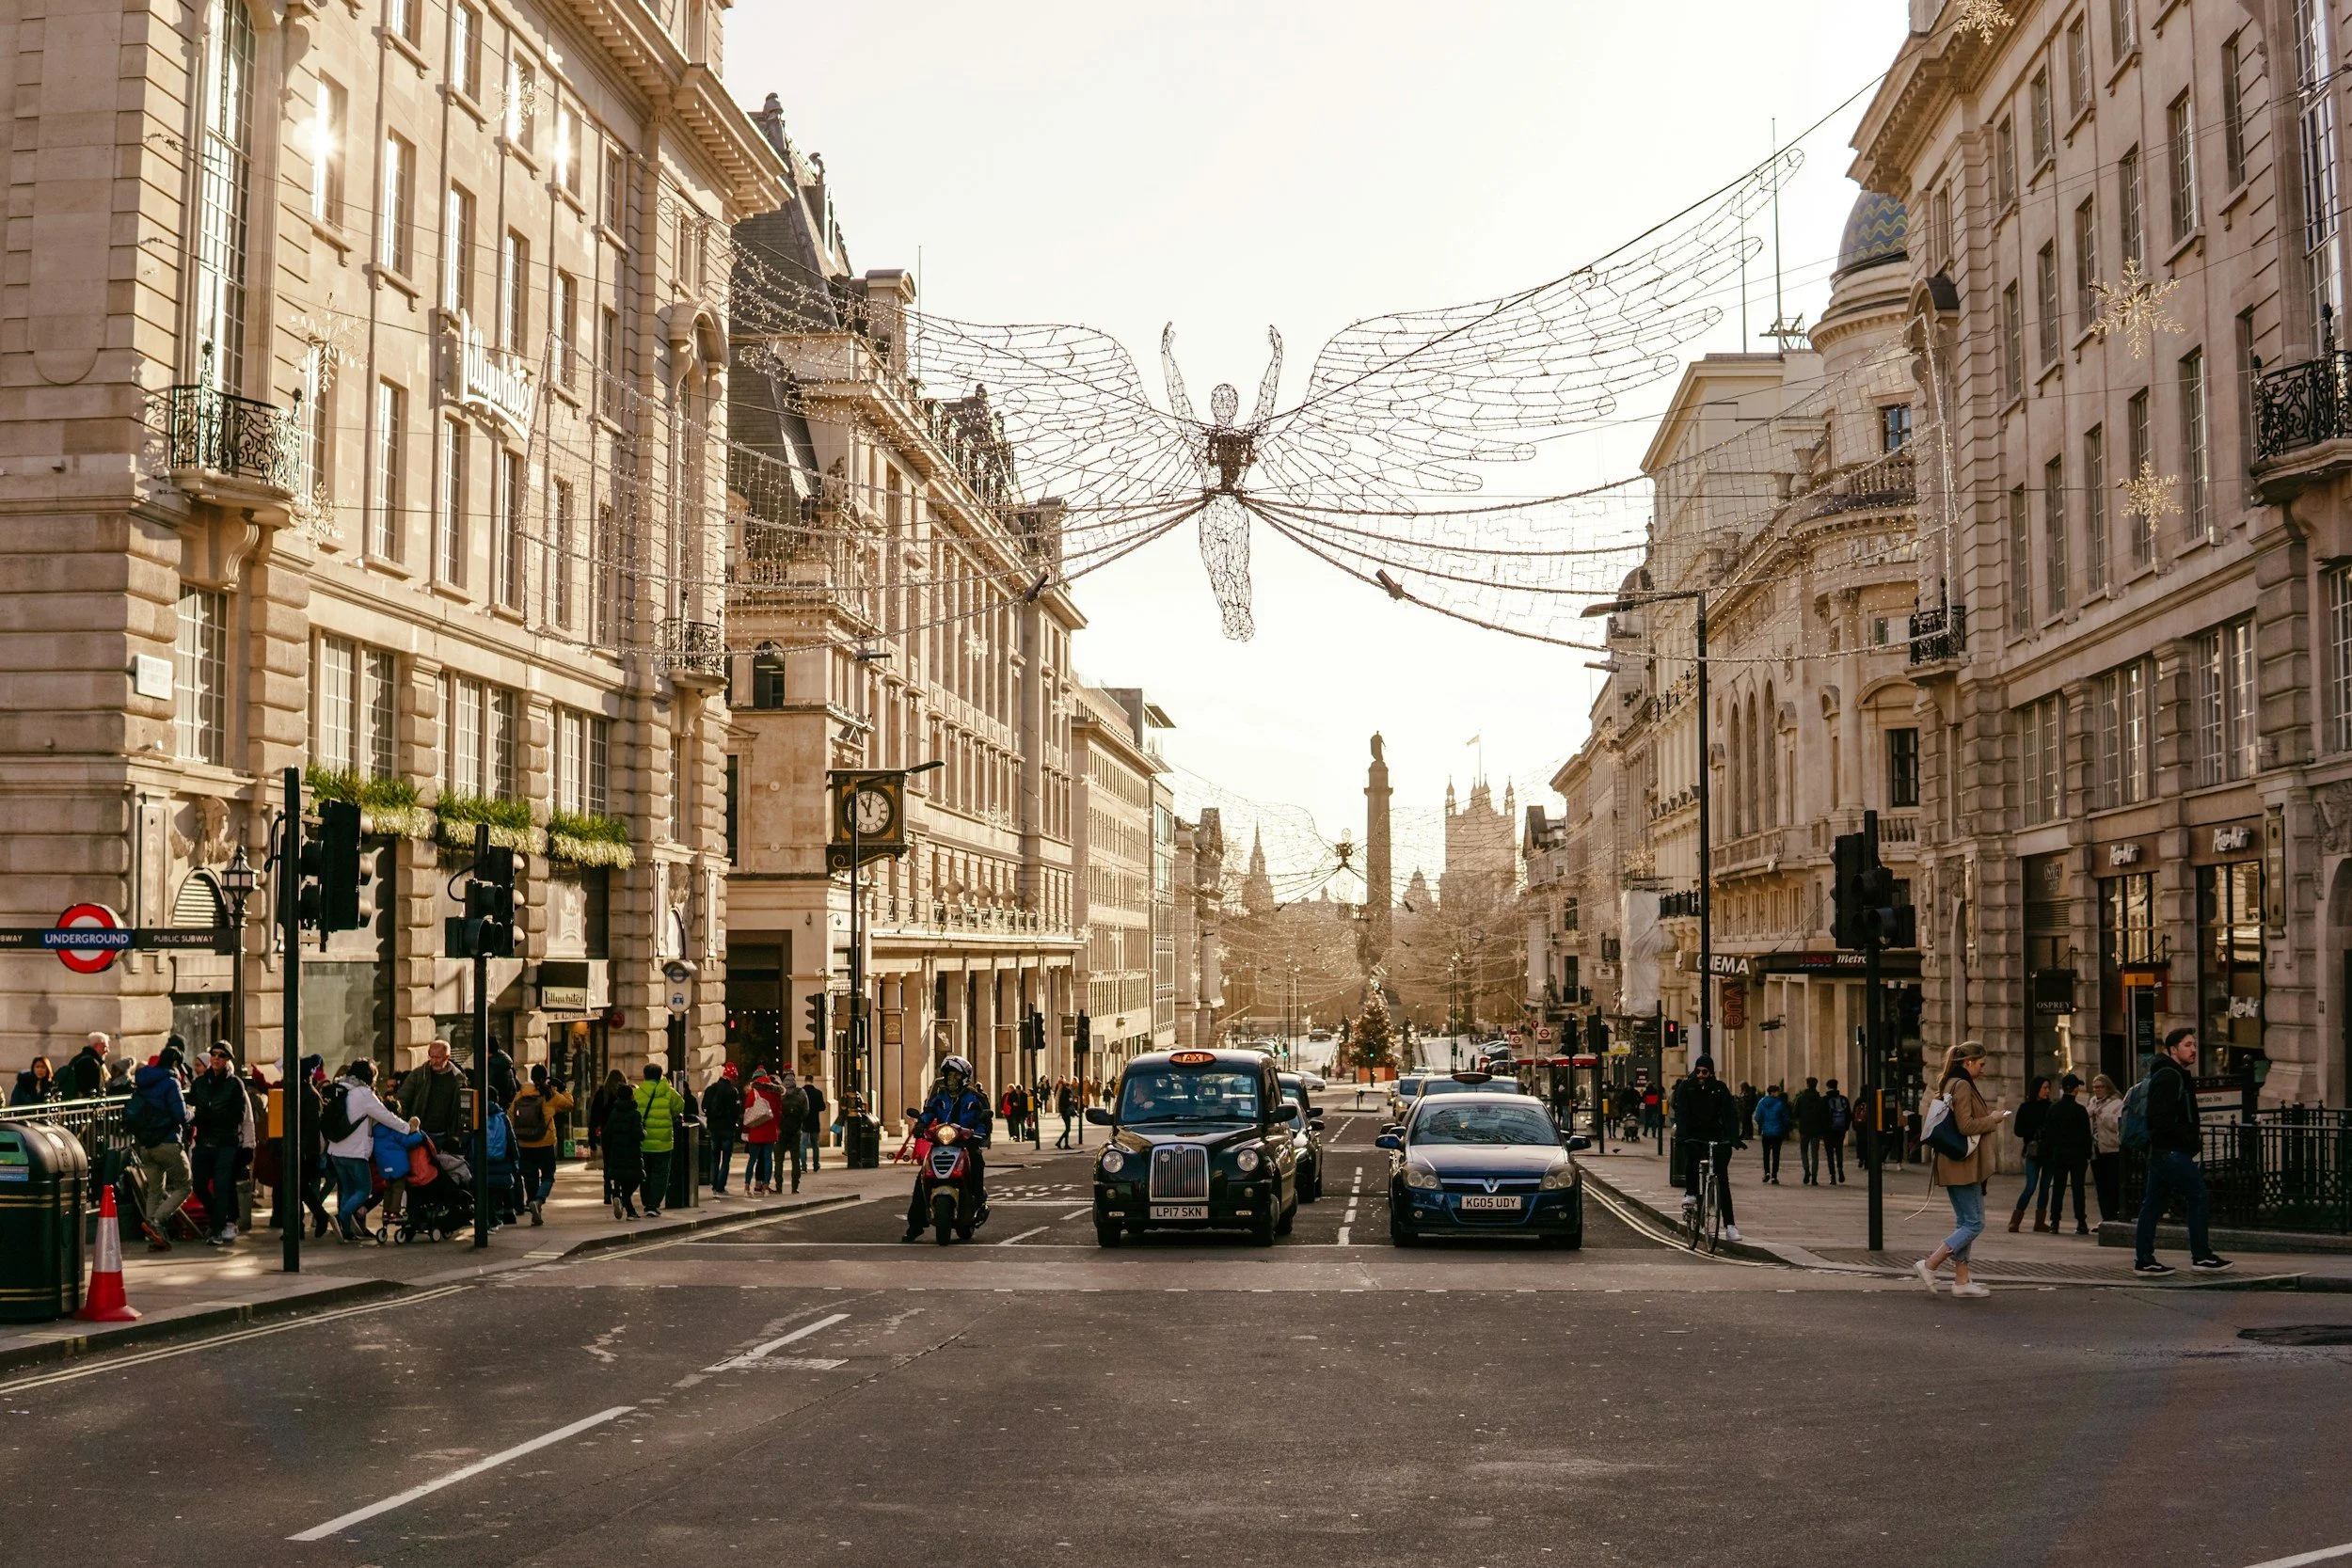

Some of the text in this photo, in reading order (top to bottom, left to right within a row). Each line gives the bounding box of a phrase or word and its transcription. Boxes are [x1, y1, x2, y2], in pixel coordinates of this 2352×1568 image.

[460, 308, 534, 442] Lillywhites
[44, 934, 129, 944] UNDERGROUND
[545, 990, 583, 1006] Lillywhites
[2036, 1001, 2071, 1009] OSPREY
[1466, 1197, 1517, 1208] KG05 UDY
[1156, 1207, 1201, 1217] LP17 SKN
